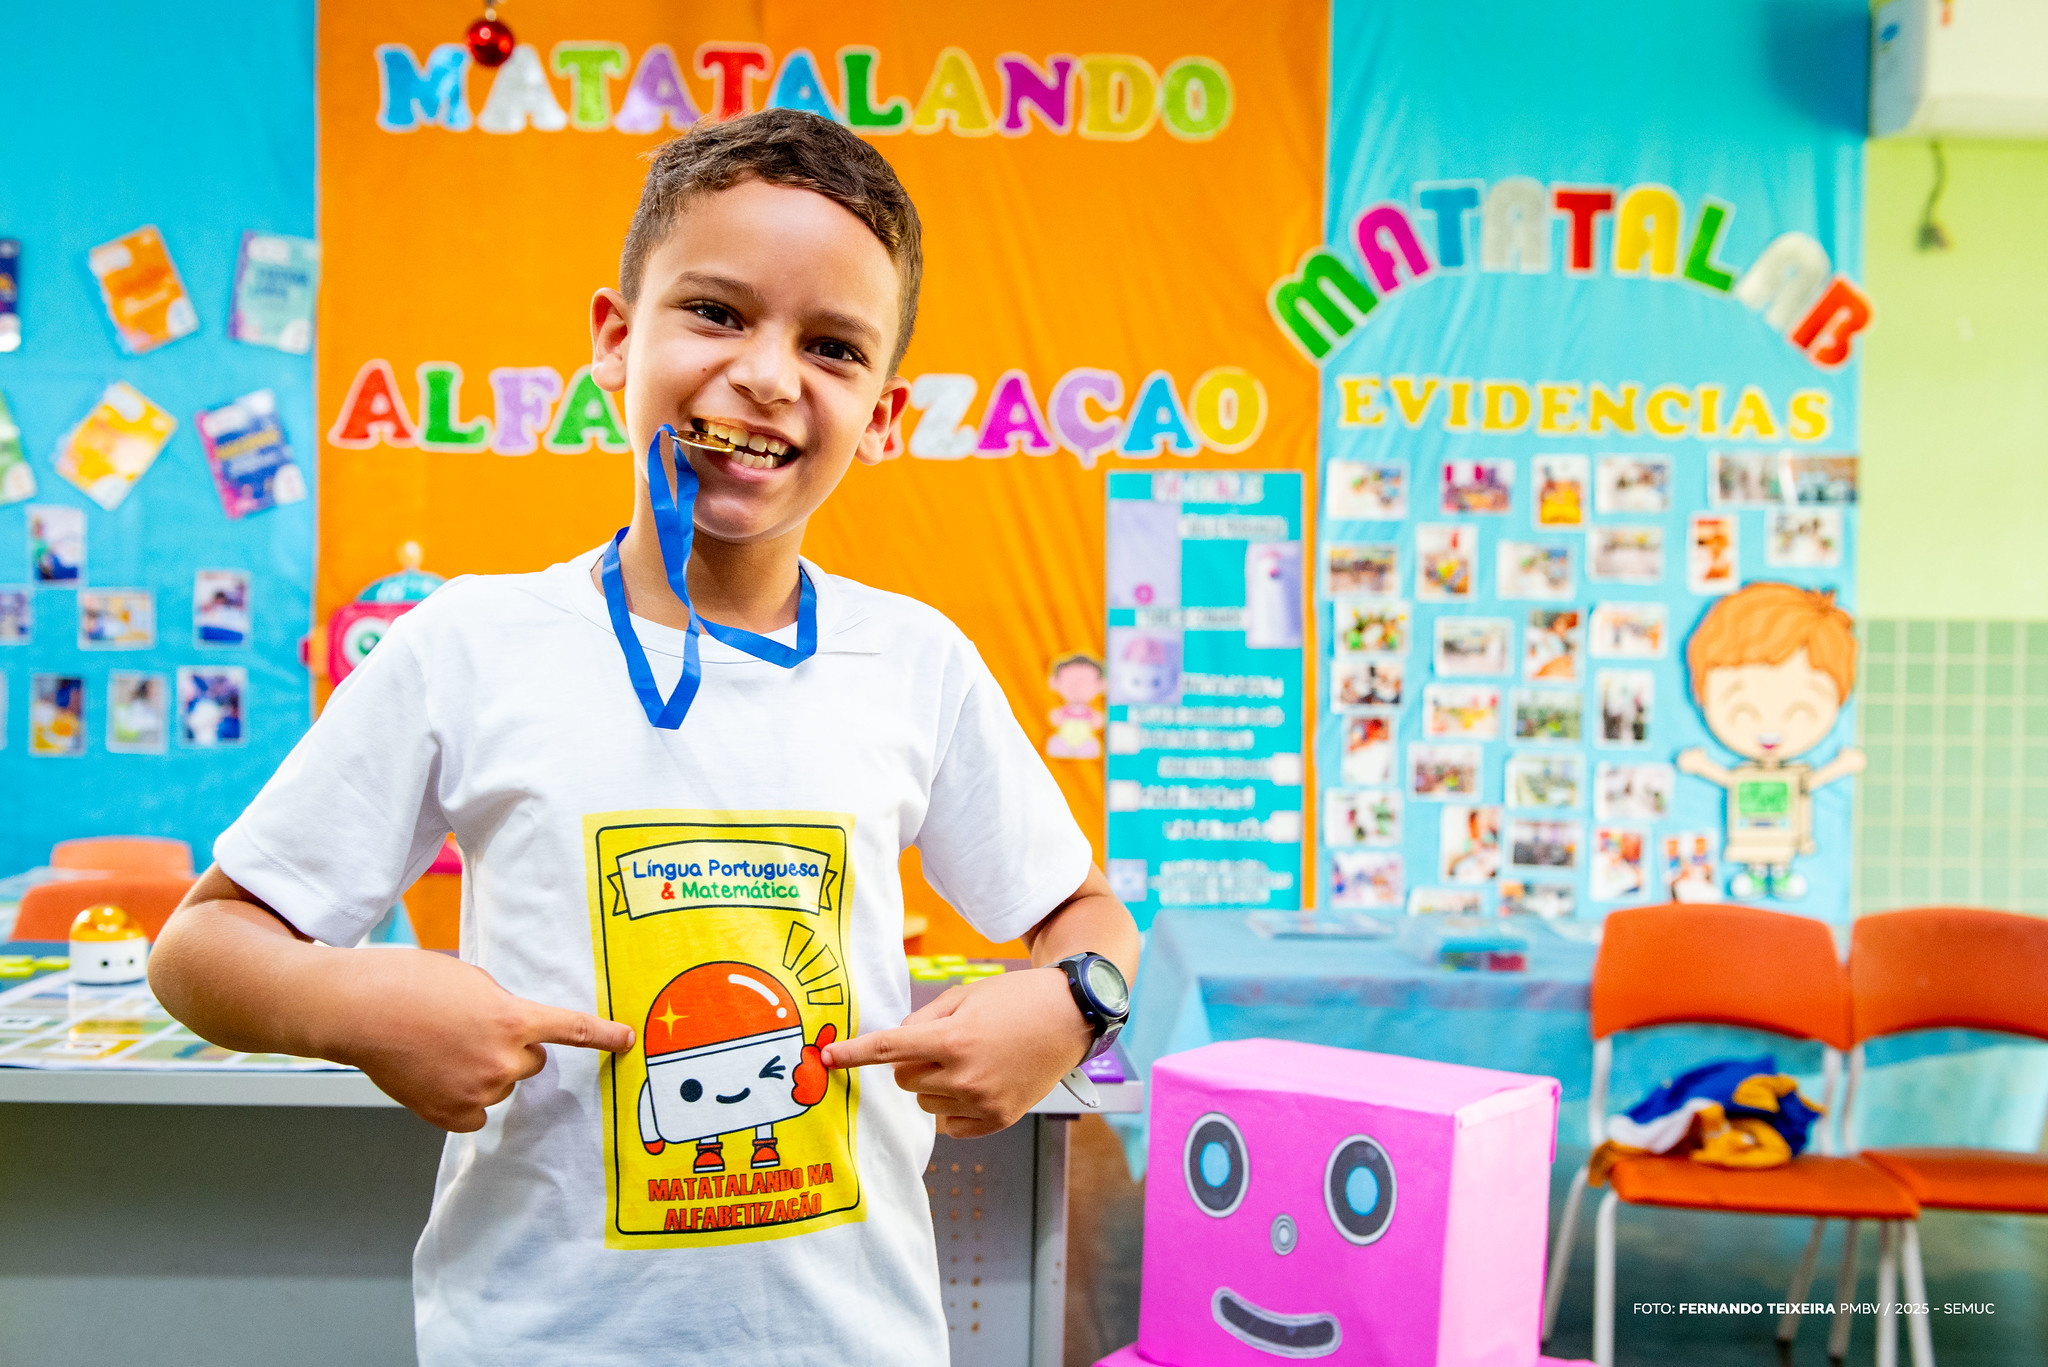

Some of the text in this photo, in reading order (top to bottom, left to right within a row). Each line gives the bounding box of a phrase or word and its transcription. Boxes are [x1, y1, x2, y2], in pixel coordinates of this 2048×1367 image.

[376, 43, 1233, 140] MATATALANDO
[1268, 178, 1873, 368] MATATALAB
[1338, 376, 1831, 441] EVIDENCIAS
[633, 859, 819, 881] Língua Portuguesa
[661, 881, 800, 900] & Matemática
[648, 1163, 833, 1201] MATATALANDO NA
[664, 1191, 822, 1231] ALFABETIZAÇÃO
